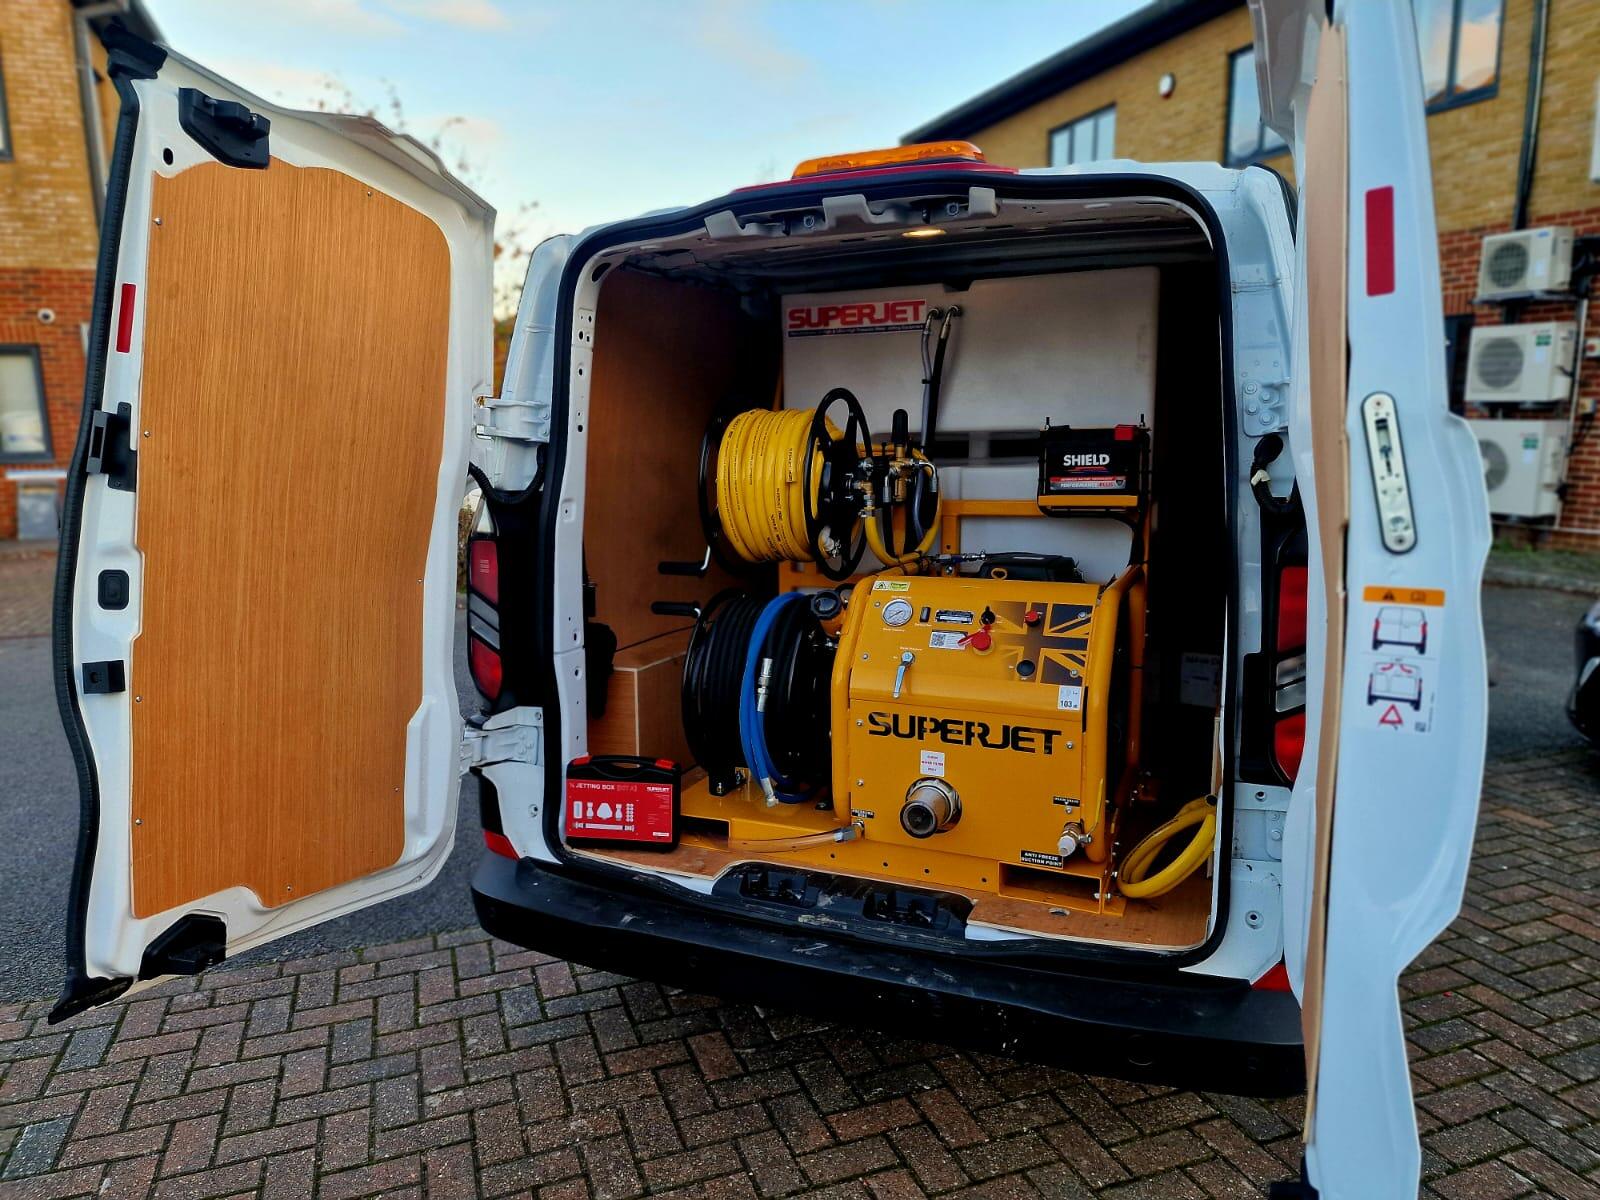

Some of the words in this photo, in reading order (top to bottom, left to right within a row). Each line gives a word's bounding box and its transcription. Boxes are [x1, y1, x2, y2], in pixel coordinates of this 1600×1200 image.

[788, 300, 926, 329] SUPERJET
[1063, 453, 1110, 467] SHIELD
[1060, 700, 1073, 708] 103
[868, 711, 1062, 755] SUPERJET
